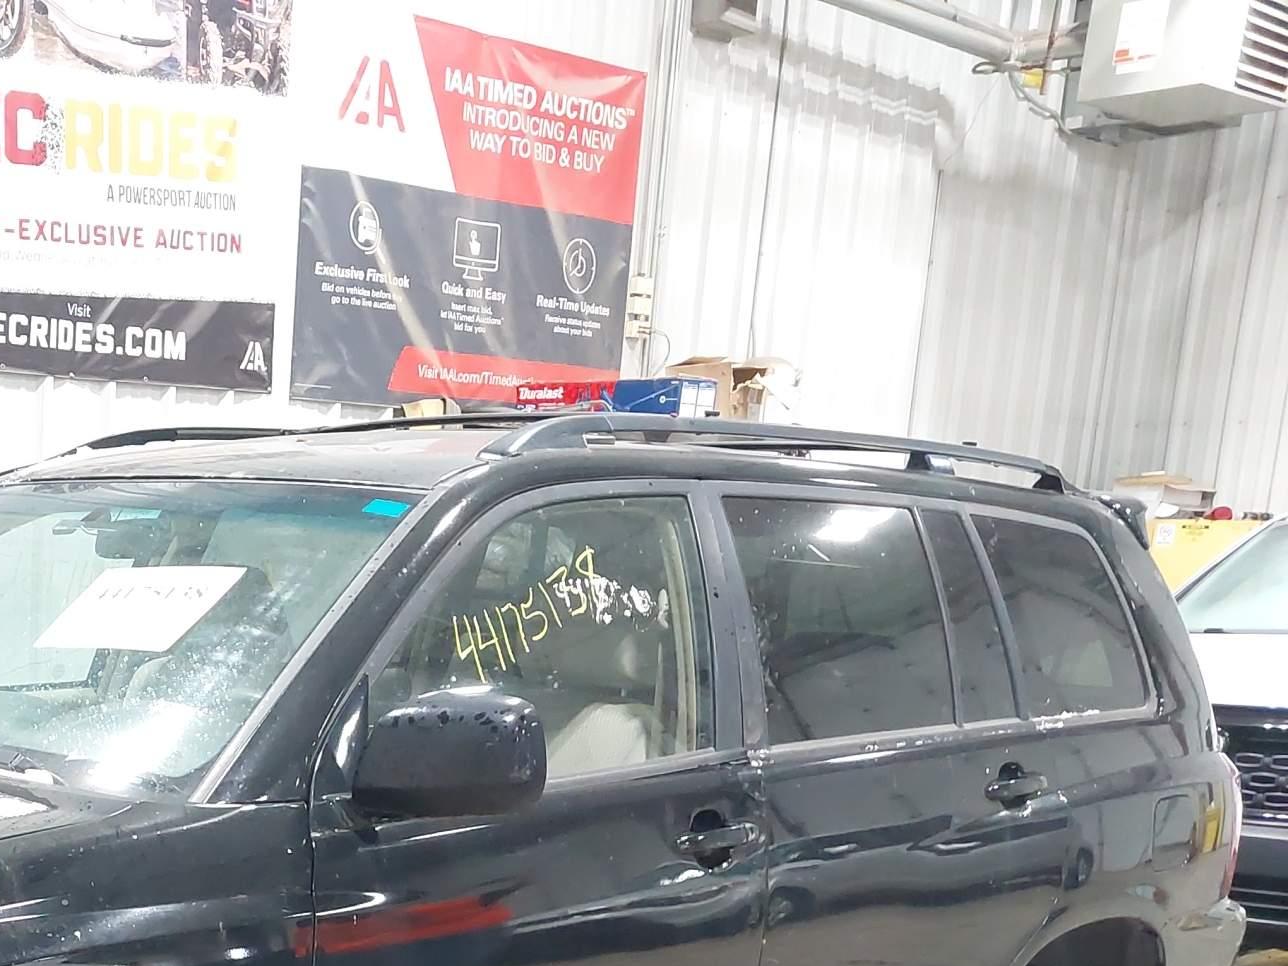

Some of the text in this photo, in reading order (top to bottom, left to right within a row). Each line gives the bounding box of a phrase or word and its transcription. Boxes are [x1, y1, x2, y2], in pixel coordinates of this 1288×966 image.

[444, 66, 475, 97] IAA
[477, 75, 537, 110] TIMED
[462, 101, 616, 152] INTRODUCING A NEW
[469, 128, 606, 173] WAY TO BID & BUY
[106, 183, 237, 212] A POWERSPORT AUCTION
[154, 227, 243, 254] AUCTION
[314, 261, 365, 281] Exclusive
[441, 280, 507, 305] Quick and Easy
[66, 301, 91, 318] Visit
[536, 294, 610, 317] Real-Time Updates
[418, 363, 438, 379] Visit
[518, 387, 564, 400] Duralast
